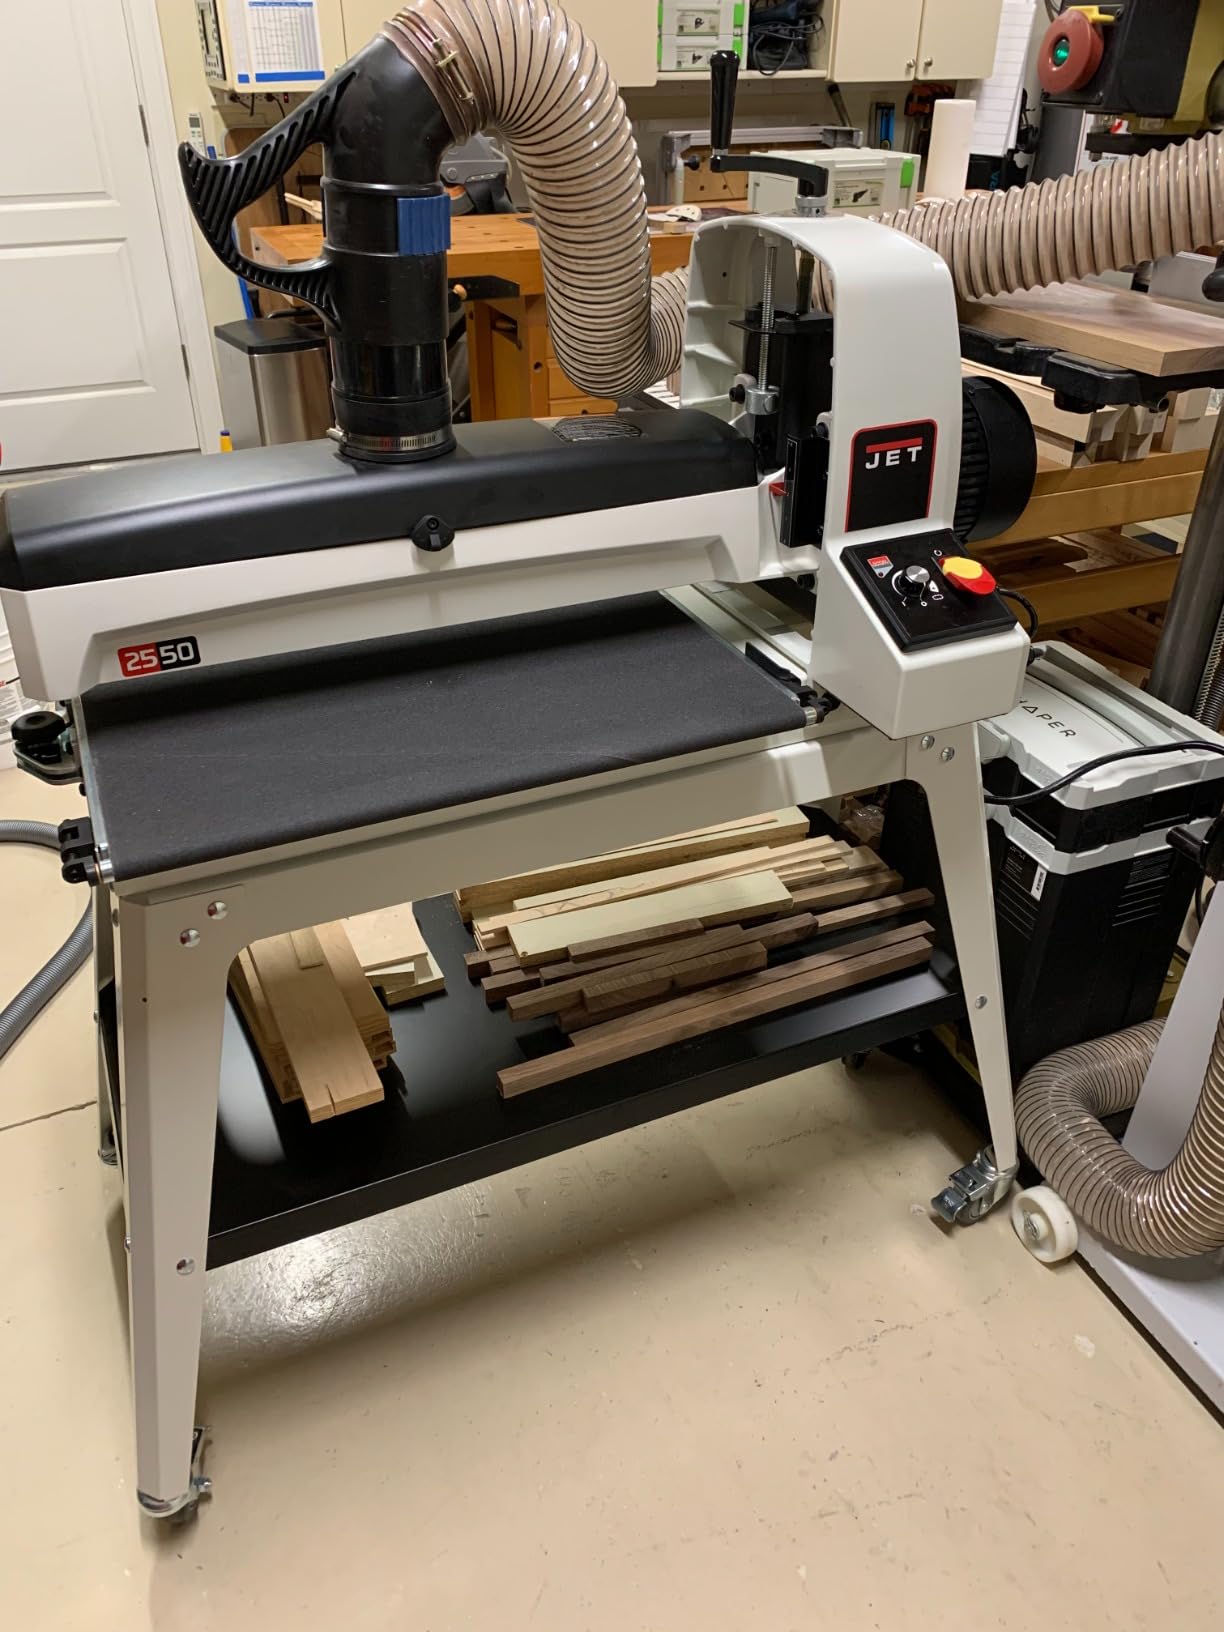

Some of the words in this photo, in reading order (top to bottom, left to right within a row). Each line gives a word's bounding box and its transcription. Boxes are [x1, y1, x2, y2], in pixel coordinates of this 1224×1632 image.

[865, 446, 922, 470] JET
[124, 642, 195, 672] 2550
[1019, 698, 1076, 737] APER
